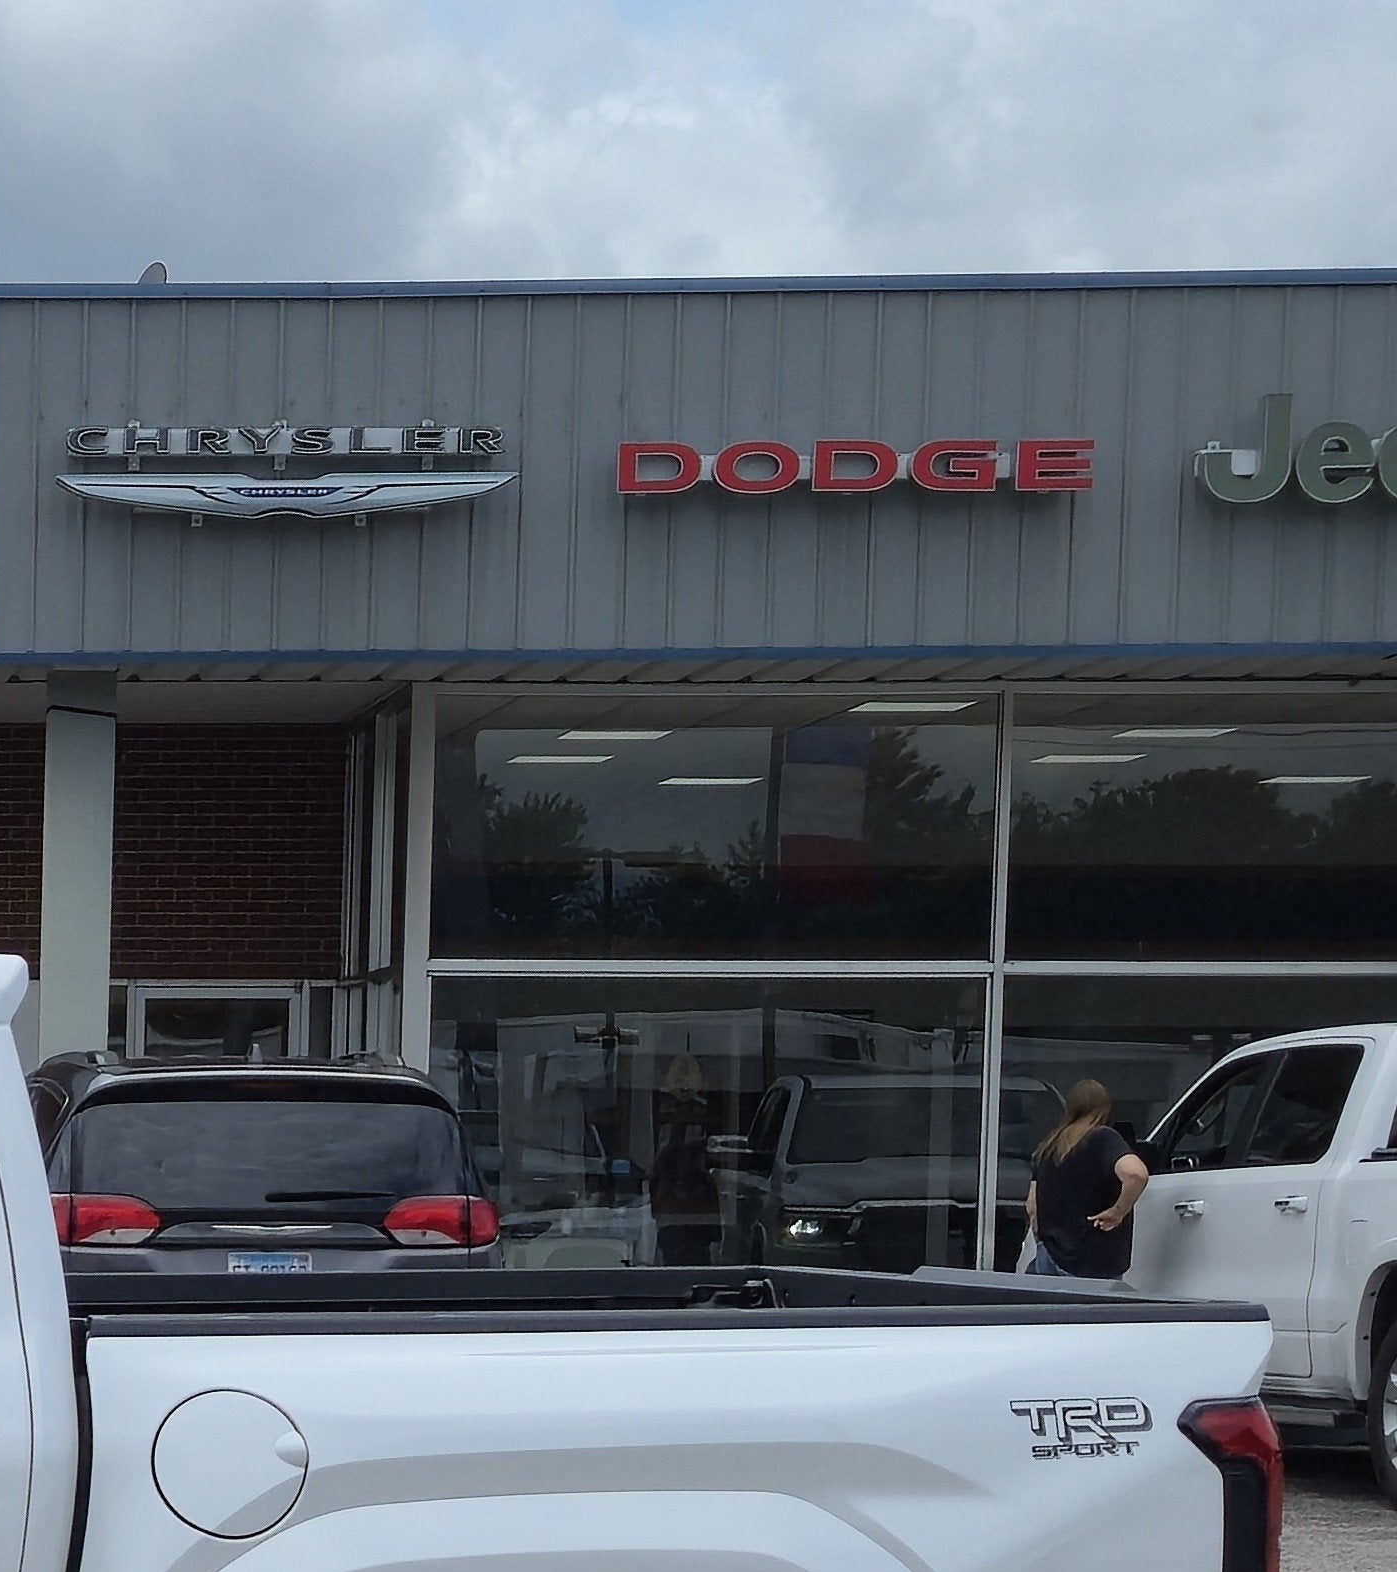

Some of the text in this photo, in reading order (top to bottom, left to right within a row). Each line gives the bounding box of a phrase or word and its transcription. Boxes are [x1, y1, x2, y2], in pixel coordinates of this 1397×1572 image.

[66, 426, 505, 456] CHRYSLER
[1204, 392, 1397, 504] Je
[617, 440, 1096, 494] DODGE
[1009, 1397, 1154, 1445] TRD
[1031, 1441, 1140, 1460] SPORT
